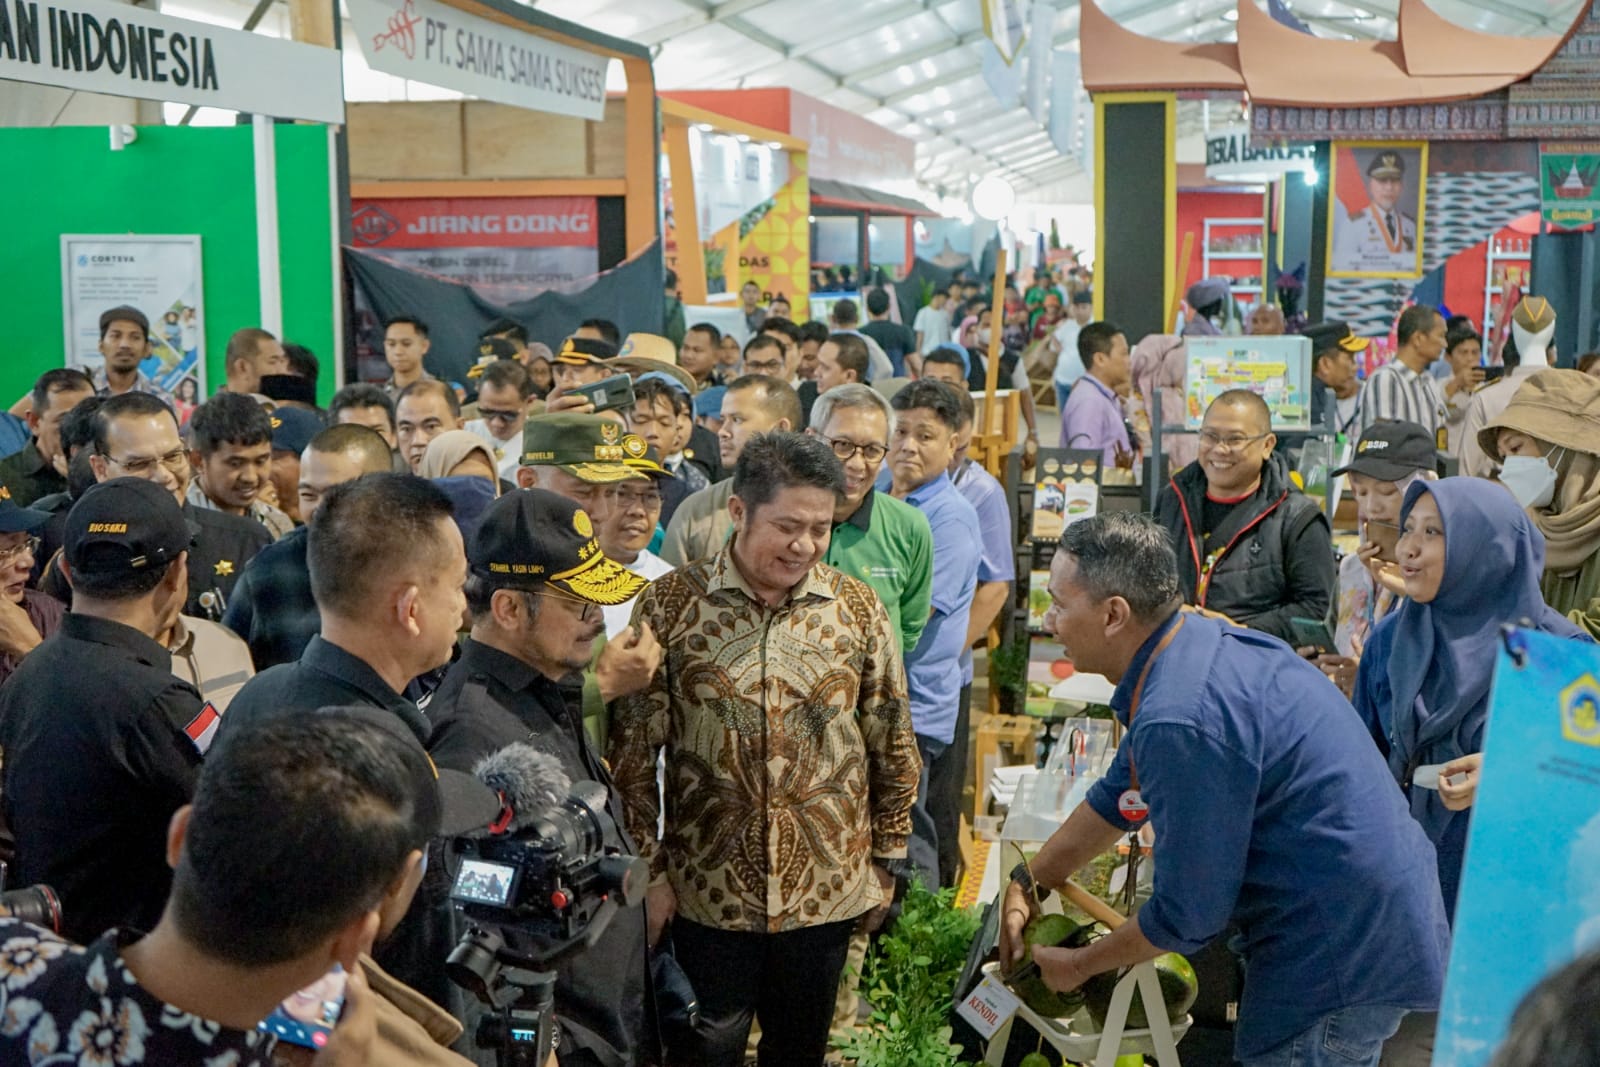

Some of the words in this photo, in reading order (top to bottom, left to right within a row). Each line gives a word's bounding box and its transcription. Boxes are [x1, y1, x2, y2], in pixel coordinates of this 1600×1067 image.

[48, 6, 219, 91] INDONESIA
[425, 17, 450, 64] PT.
[456, 28, 505, 81] SAMA
[510, 45, 552, 91] SAMA
[557, 58, 602, 103] SUKSES
[407, 215, 500, 234] JIANG
[506, 214, 590, 233] DONG
[91, 255, 135, 263] CORTEVA
[88, 522, 128, 534] BIOSAKA
[968, 995, 999, 1026] KENDIL
